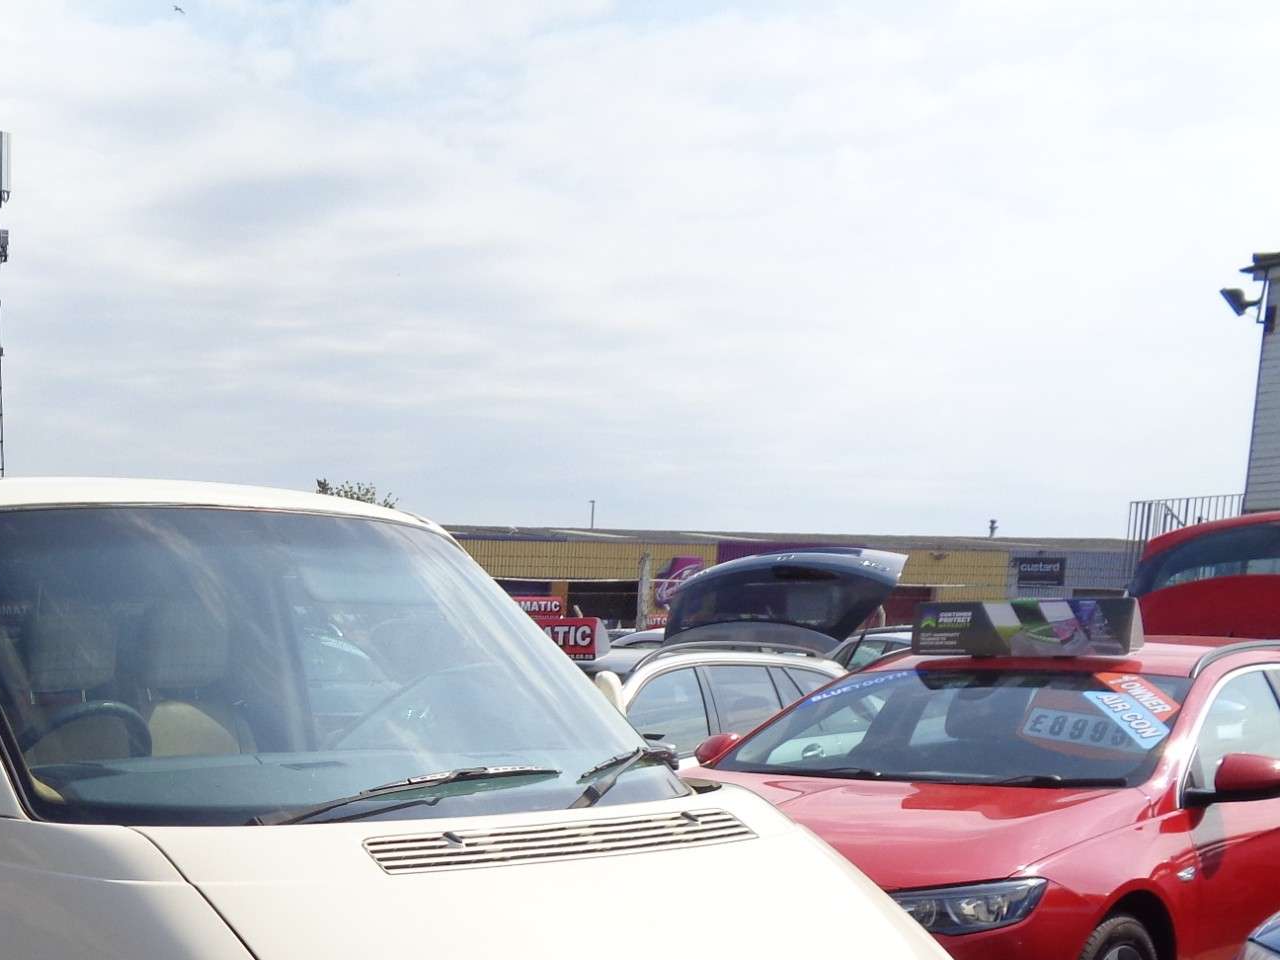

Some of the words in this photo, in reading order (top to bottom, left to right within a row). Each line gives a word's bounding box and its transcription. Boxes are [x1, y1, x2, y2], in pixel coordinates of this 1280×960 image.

[519, 600, 560, 611] MATIC
[1096, 693, 1130, 713] AIR
[1122, 711, 1161, 739] CON
